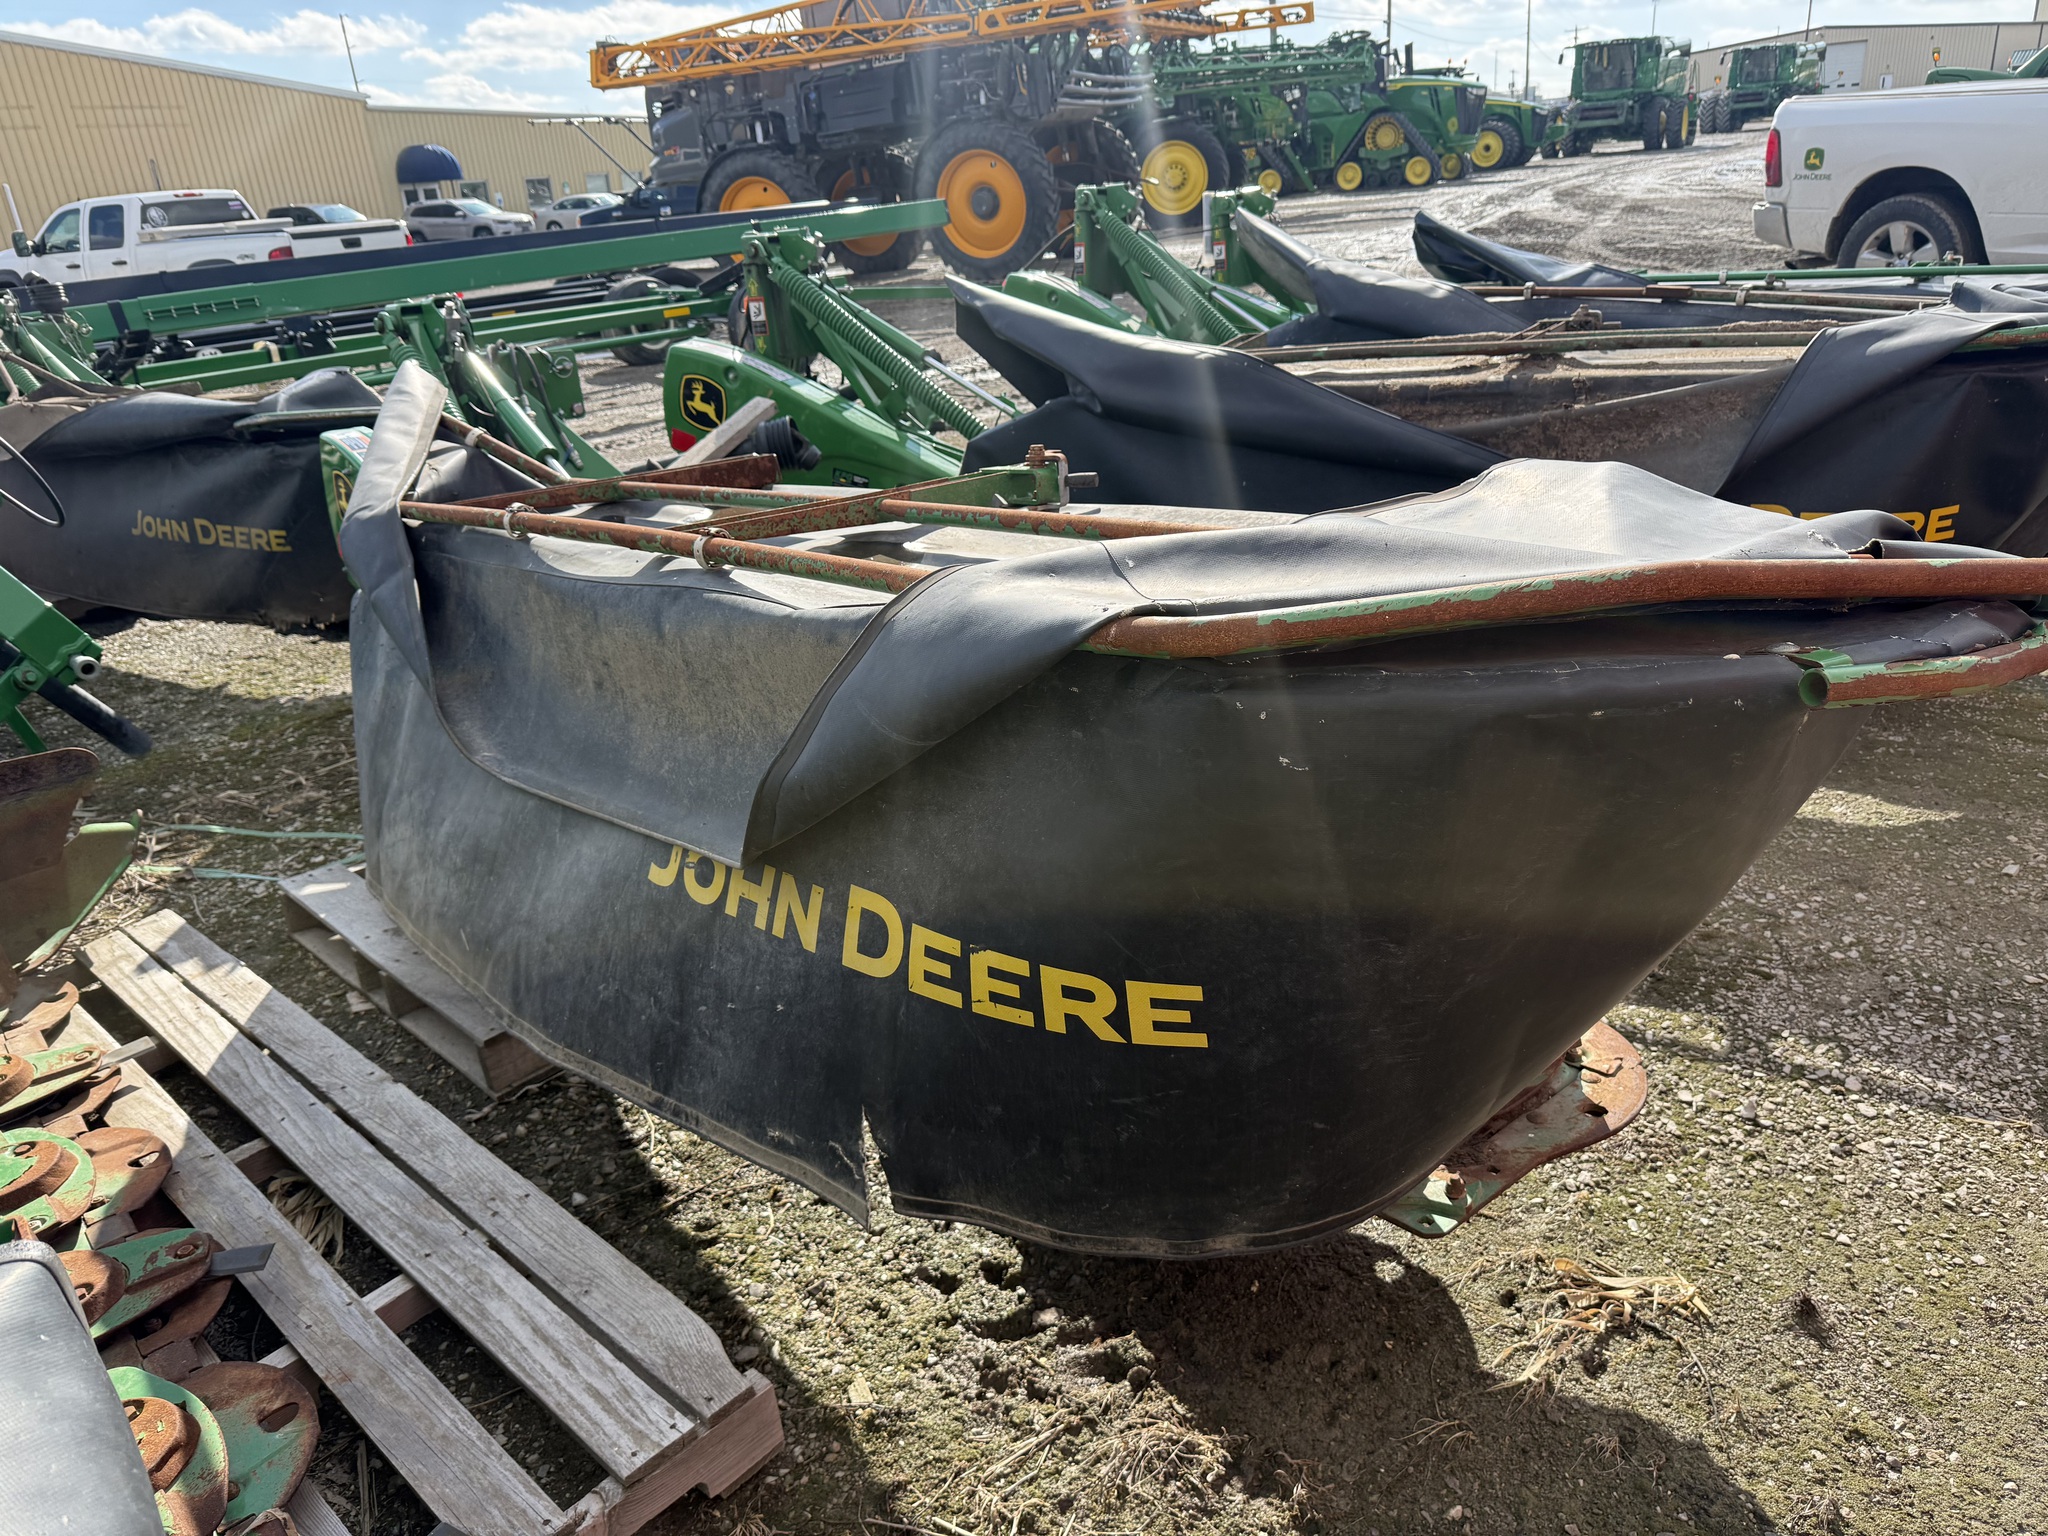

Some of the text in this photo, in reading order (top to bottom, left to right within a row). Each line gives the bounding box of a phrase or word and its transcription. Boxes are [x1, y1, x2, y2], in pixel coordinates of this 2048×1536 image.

[132, 510, 292, 552] JOHN DEERE
[648, 845, 1209, 1048] JOHN DEERE
